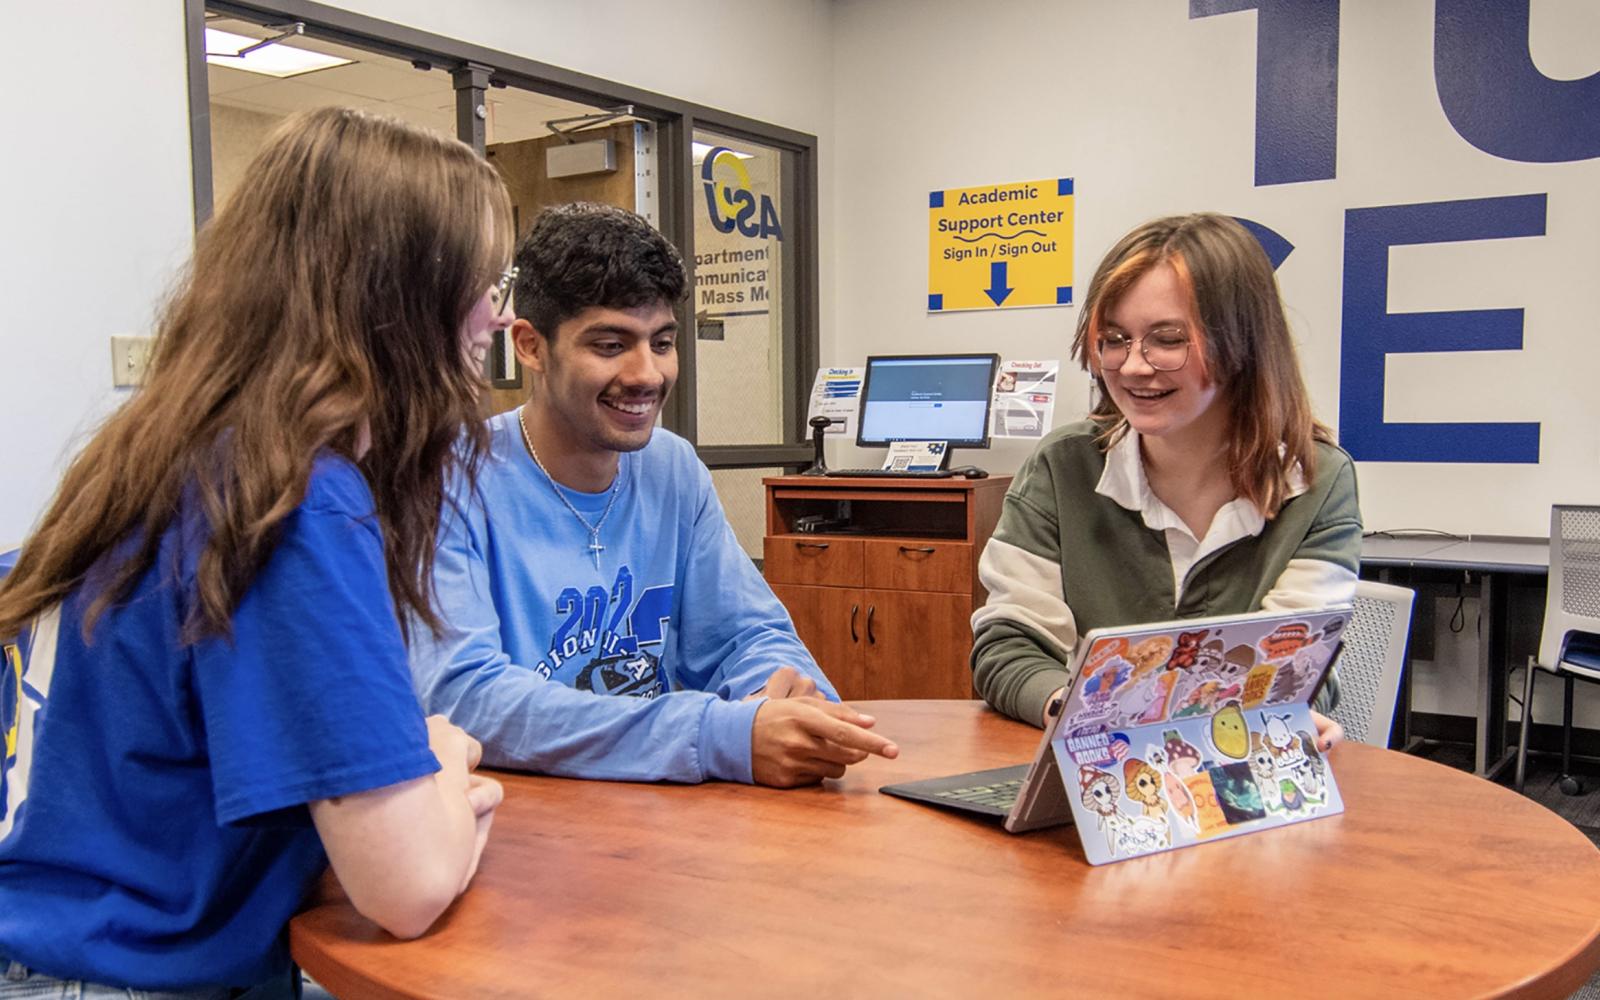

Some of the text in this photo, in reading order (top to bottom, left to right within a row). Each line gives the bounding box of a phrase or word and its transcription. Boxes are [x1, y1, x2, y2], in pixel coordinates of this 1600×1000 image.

[958, 185, 1038, 206] Academic
[938, 211, 1064, 234] Support Center
[943, 241, 1056, 261] Sign In / Sign Out
[702, 289, 744, 305] Mass
